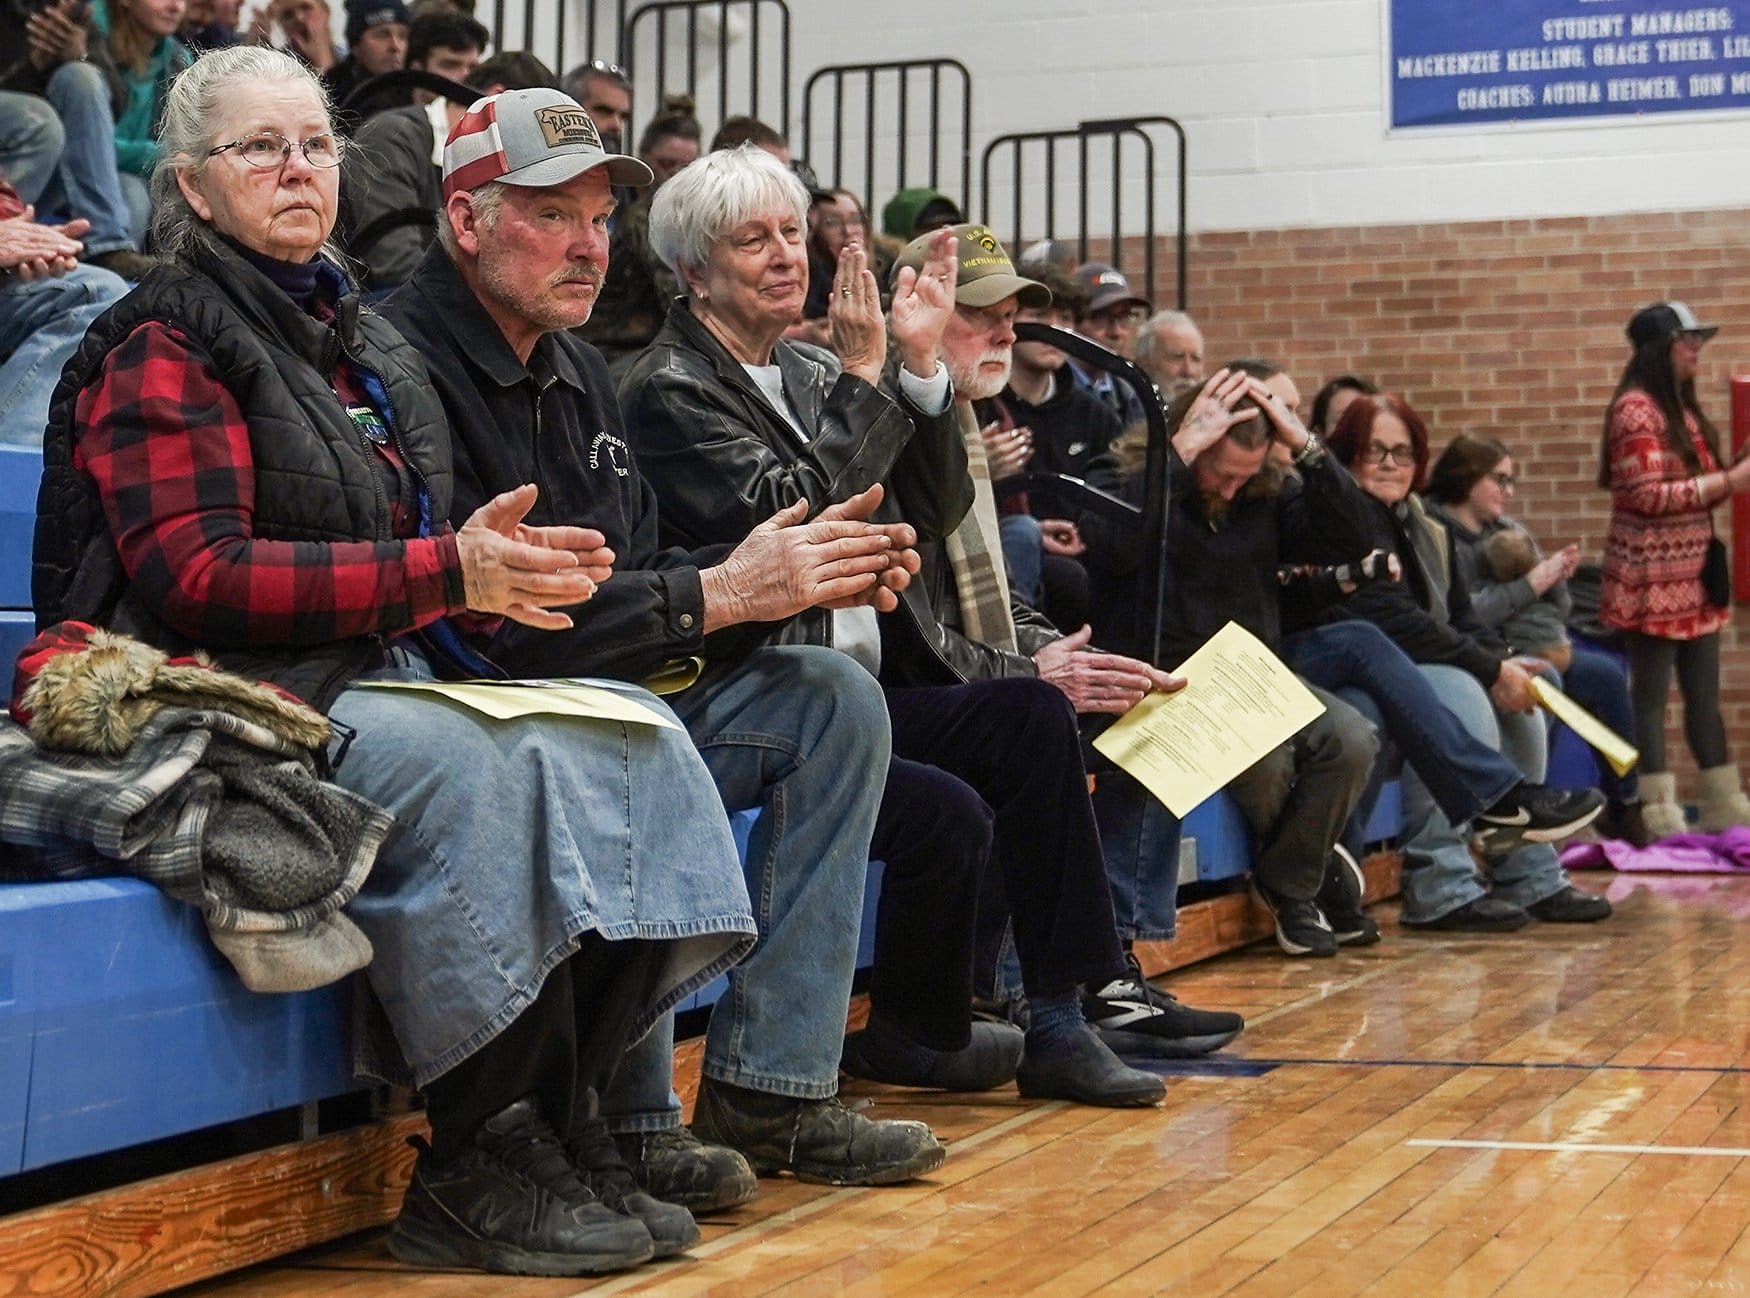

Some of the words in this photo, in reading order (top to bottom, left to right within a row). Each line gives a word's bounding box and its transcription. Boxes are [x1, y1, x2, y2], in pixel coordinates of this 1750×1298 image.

[1542, 14, 1624, 41] STUDENT
[1397, 50, 1501, 79] MACKENZIE
[1592, 41, 1650, 66] GRACE
